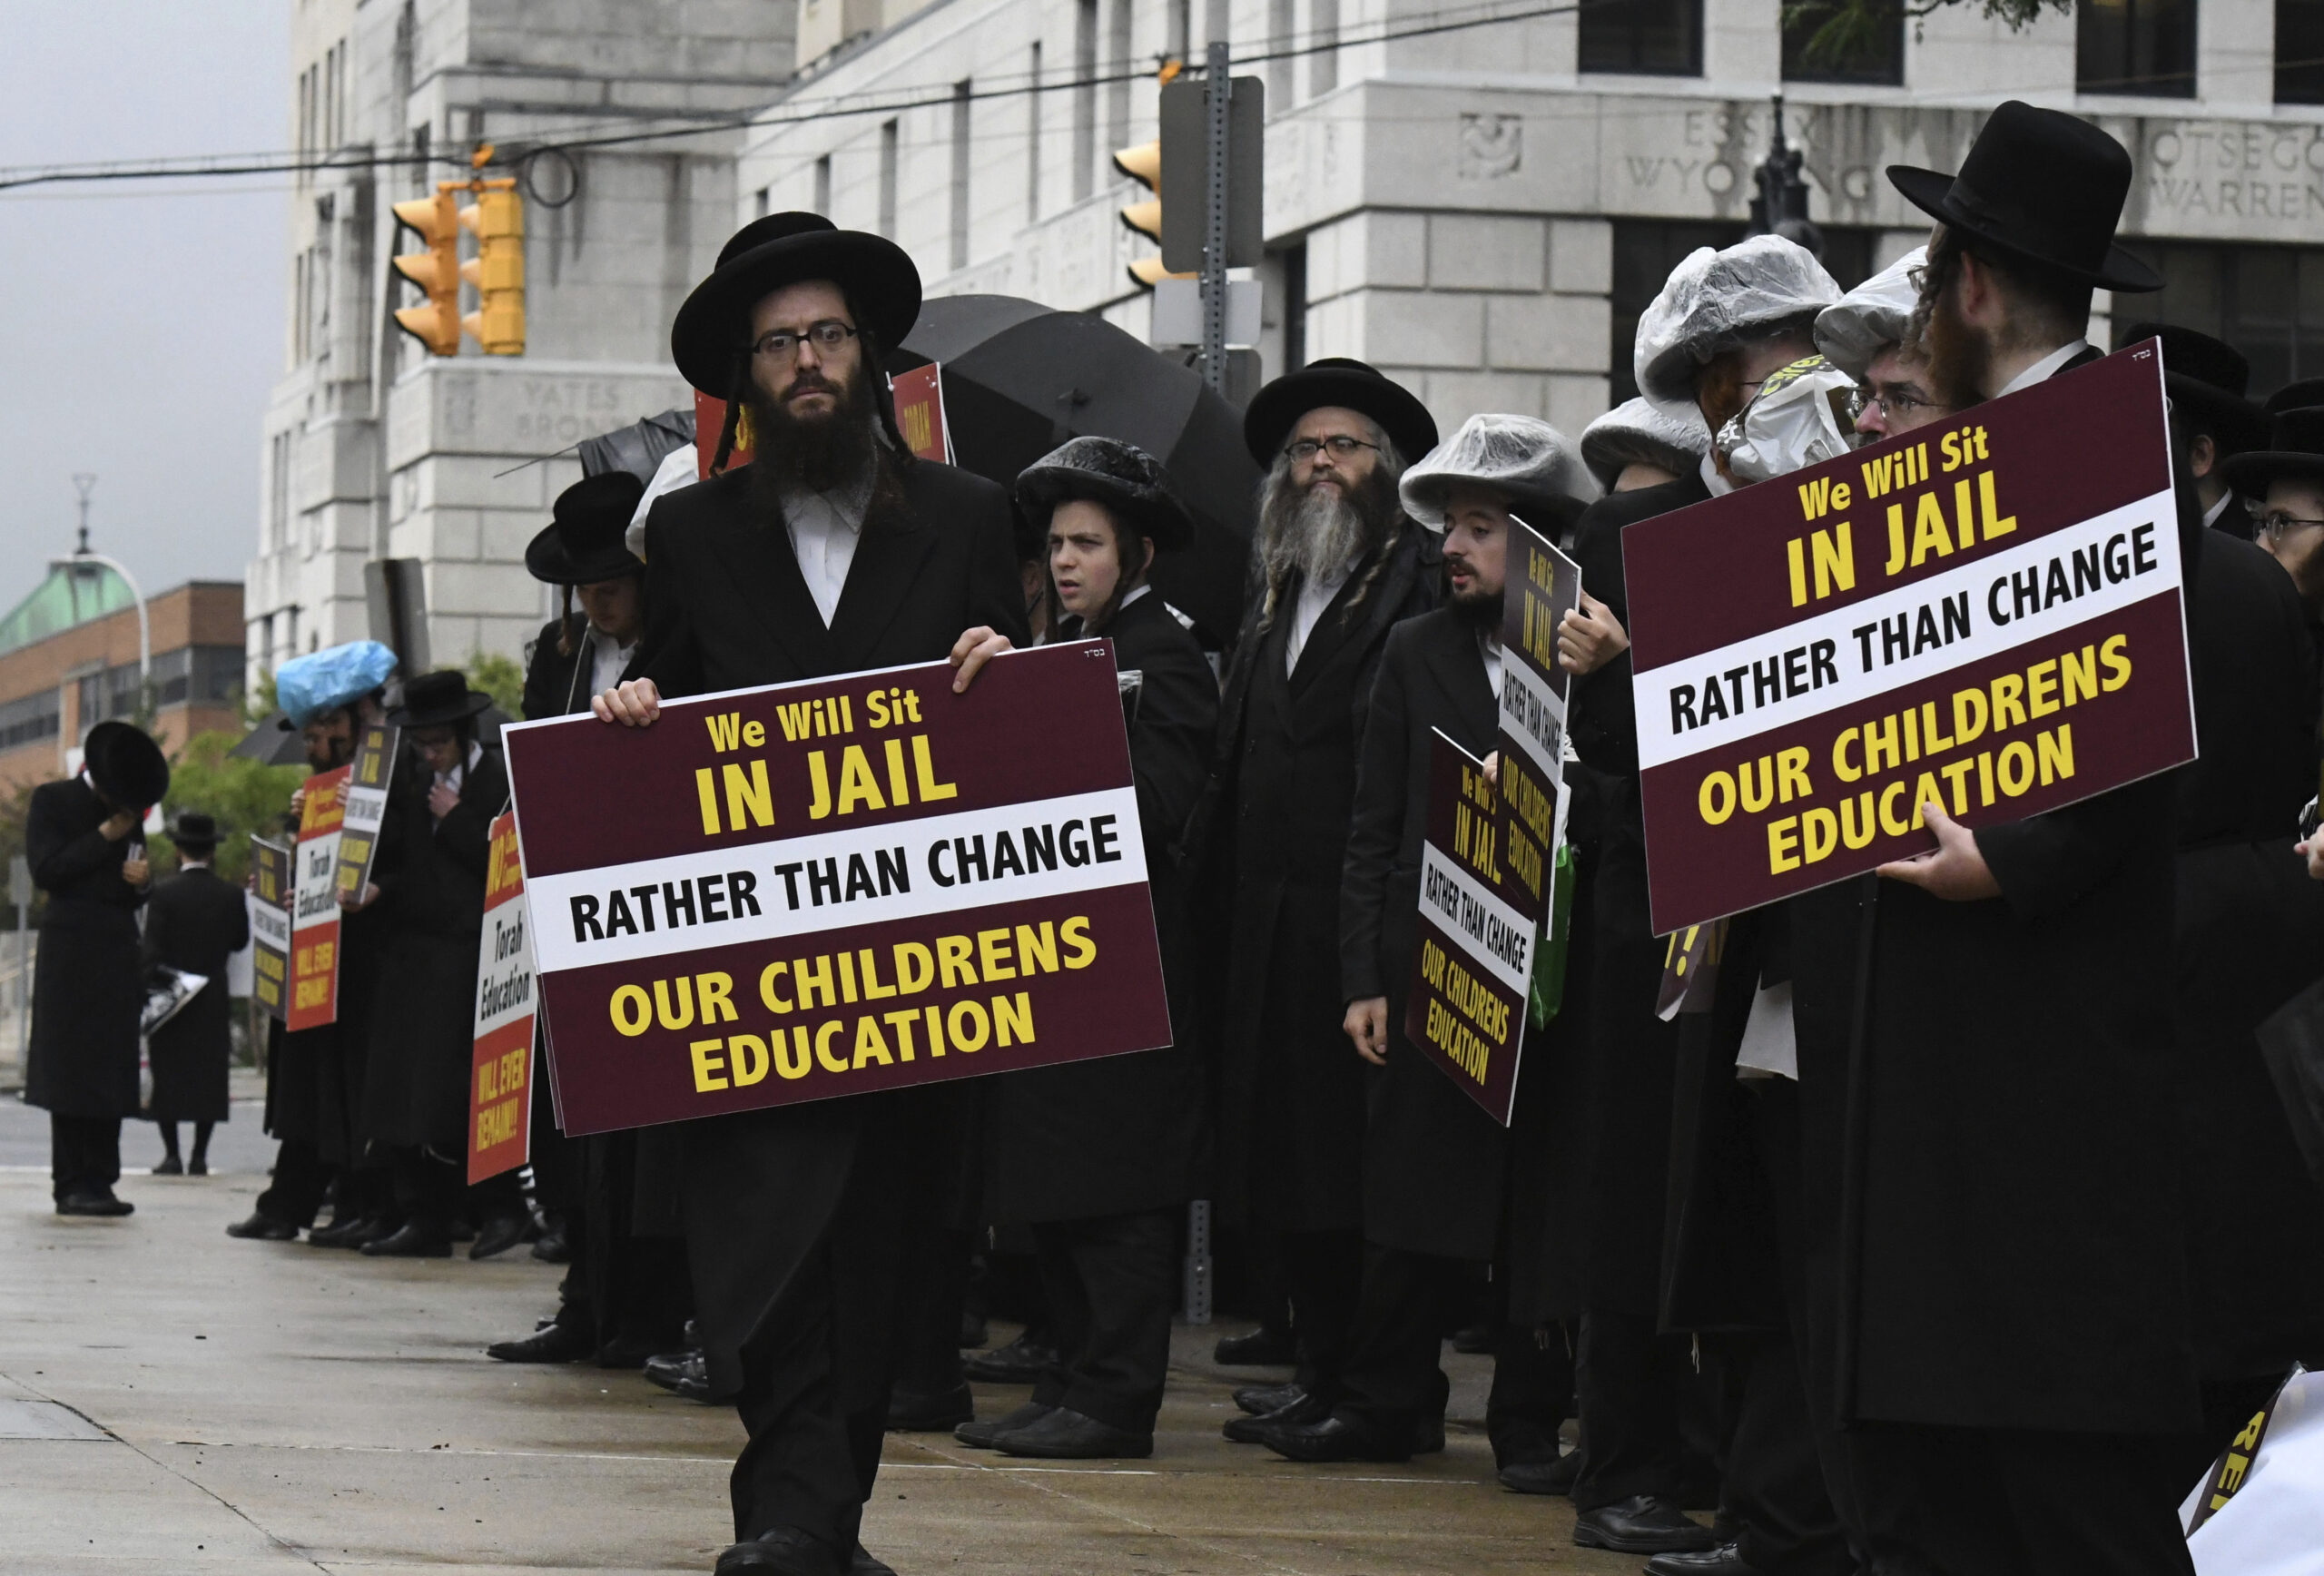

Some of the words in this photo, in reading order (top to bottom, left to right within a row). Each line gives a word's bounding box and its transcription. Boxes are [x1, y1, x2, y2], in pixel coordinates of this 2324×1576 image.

[1685, 110, 1817, 151] ESSX
[524, 380, 620, 409] YATES
[1799, 477, 1851, 521] We
[1862, 442, 1929, 499] Will
[1941, 426, 1989, 473] Sit
[1787, 521, 1856, 607] IN
[1886, 470, 2017, 576] JAIL
[1522, 588, 1534, 654] IN
[1534, 599, 1551, 671] JAIL
[1670, 638, 1839, 735] RATHER
[1853, 590, 1970, 674] THAN
[1988, 522, 2158, 626] CHANGE
[705, 712, 765, 753] We
[776, 694, 853, 741] Will
[867, 687, 922, 729] Sit
[1503, 668, 1526, 728] RATHER
[1526, 689, 1542, 744] THAN
[1541, 704, 1561, 765] CHANGE
[1699, 745, 1813, 825] OUR
[1832, 634, 2132, 783] CHILDRENS
[695, 760, 775, 835] IN
[808, 734, 958, 820] JAIL
[1462, 764, 1472, 799] We
[1502, 755, 1519, 811] OUR
[1519, 771, 1551, 851] CHILDRENS
[1767, 724, 2075, 875] EDUCATION
[486, 834, 505, 897] NO
[569, 870, 762, 942] RATHER
[774, 846, 911, 911] THAN
[928, 814, 1122, 887] CHANGE
[1454, 801, 1471, 860] IN
[1508, 819, 1542, 901] EDUCATION
[495, 911, 523, 963] Torah
[1425, 862, 1459, 922] RATHER
[1461, 890, 1485, 944] THAN
[1487, 912, 1526, 975] CHANGE
[480, 963, 530, 1021] Education
[610, 971, 739, 1037] OUR
[759, 916, 1097, 1014] CHILDRENS
[1422, 939, 1445, 991] OUR
[1446, 960, 1510, 1045] CHILDRENS
[478, 1058, 498, 1105] WILL
[499, 1048, 526, 1096] EVER
[690, 992, 1036, 1093] EDUCATION
[1426, 997, 1489, 1086] EDUCATION
